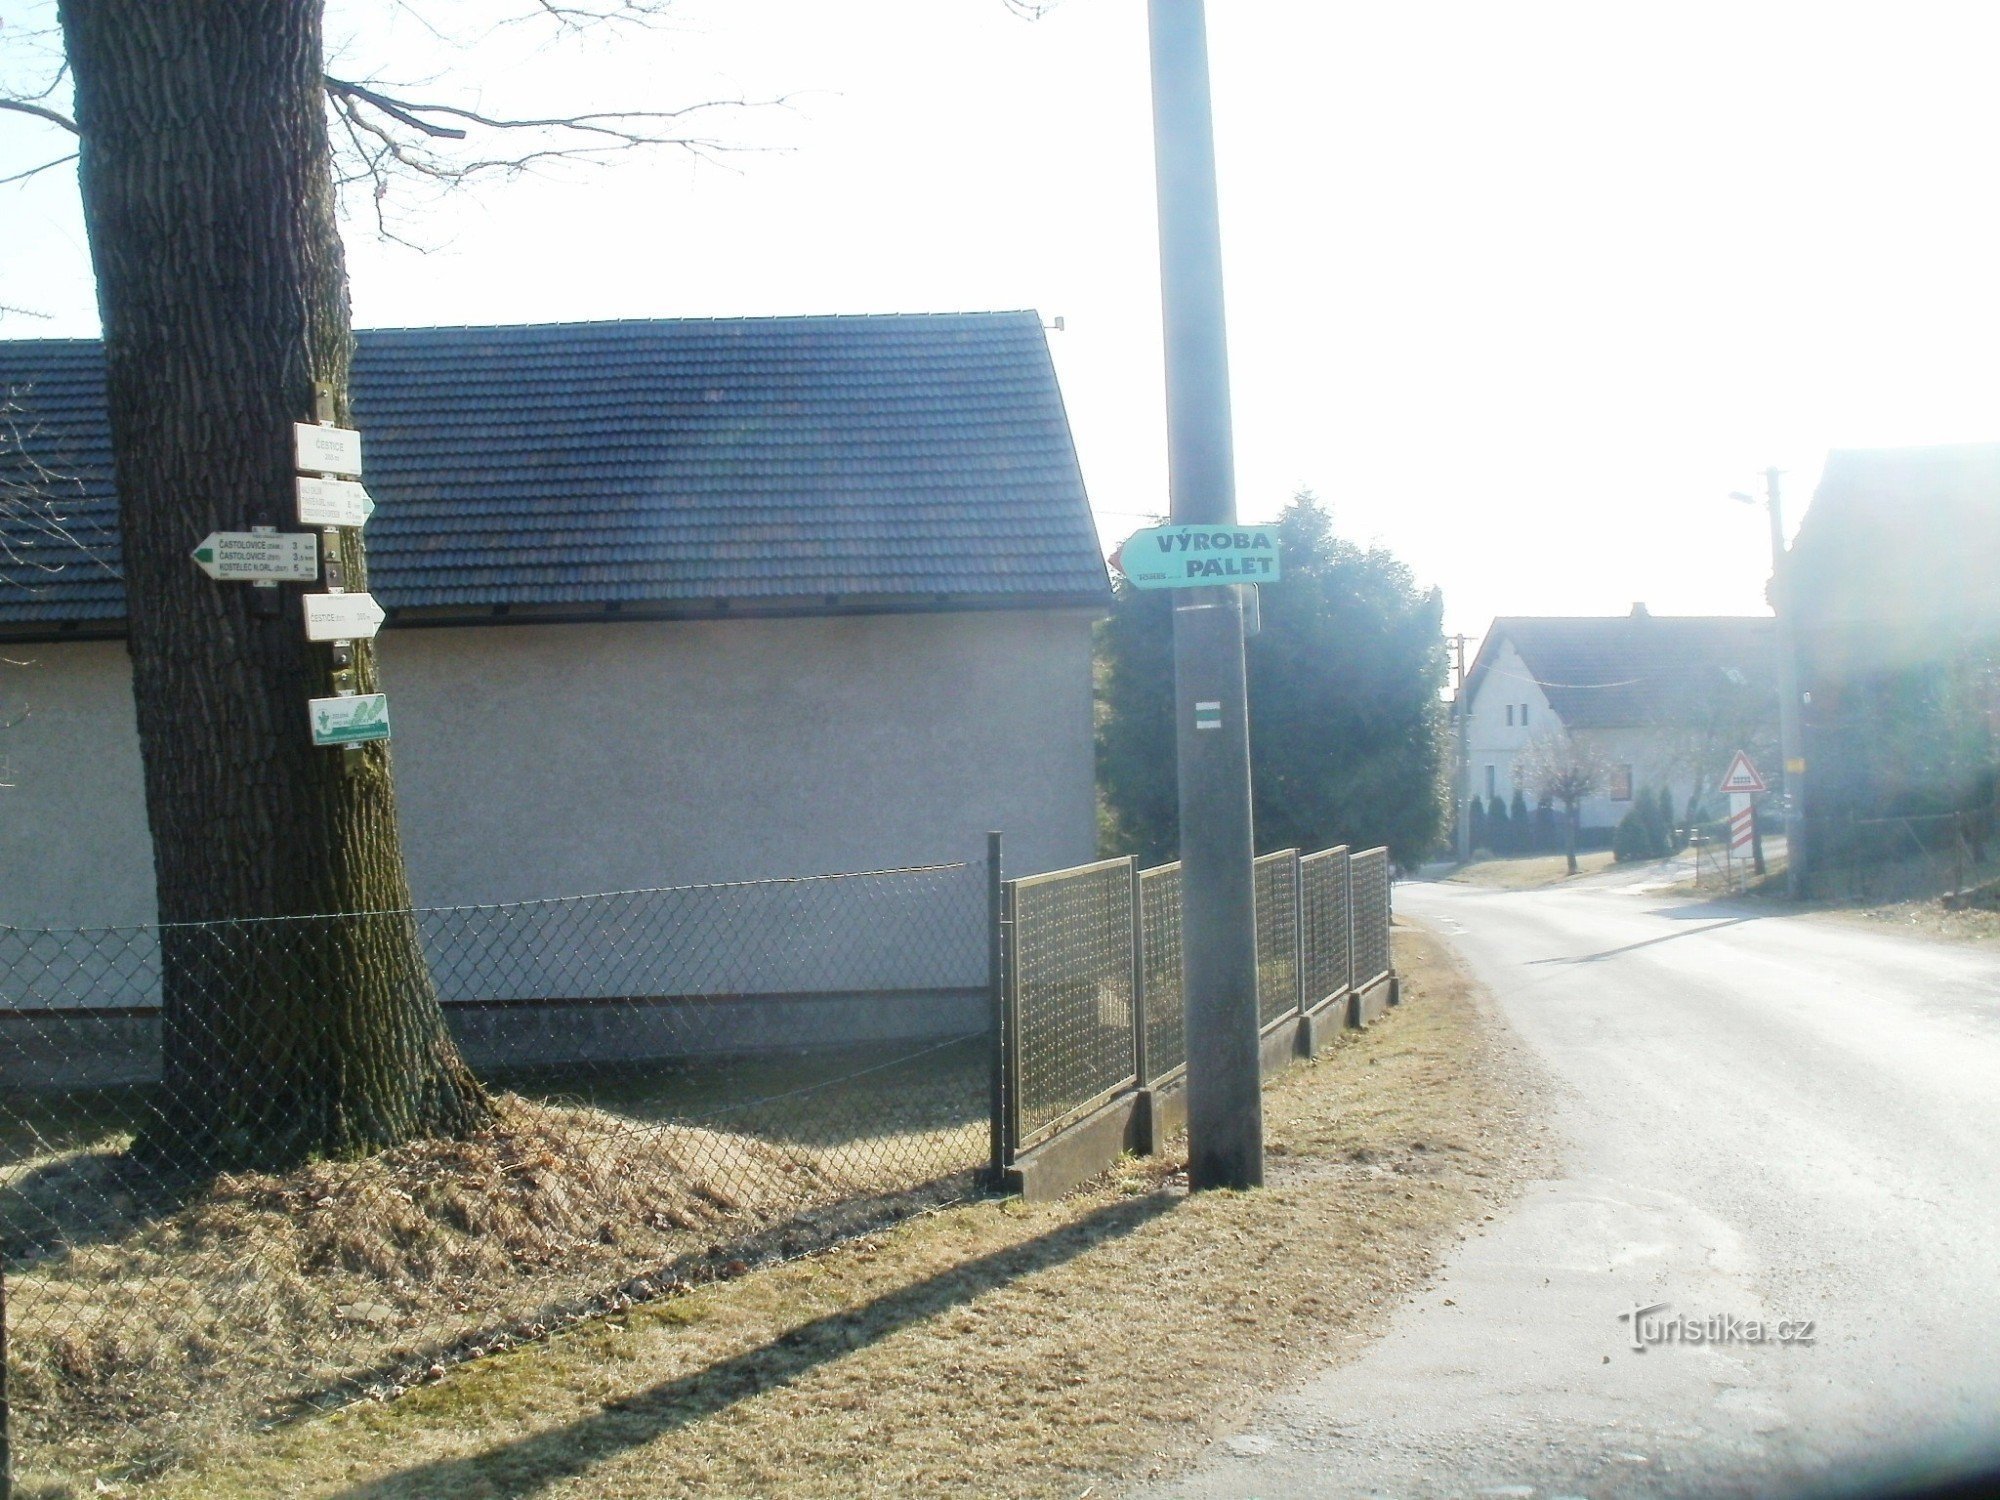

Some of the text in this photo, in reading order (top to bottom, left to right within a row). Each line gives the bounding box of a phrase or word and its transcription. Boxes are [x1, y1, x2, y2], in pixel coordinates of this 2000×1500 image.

[219, 539, 266, 549] ČASTOLOVICE
[292, 542, 298, 550] 3
[1156, 528, 1272, 553] VÝROBA
[219, 550, 266, 560] ČASTOLOVICE
[219, 562, 252, 571] KOSTELEC
[1186, 557, 1273, 578] PALET
